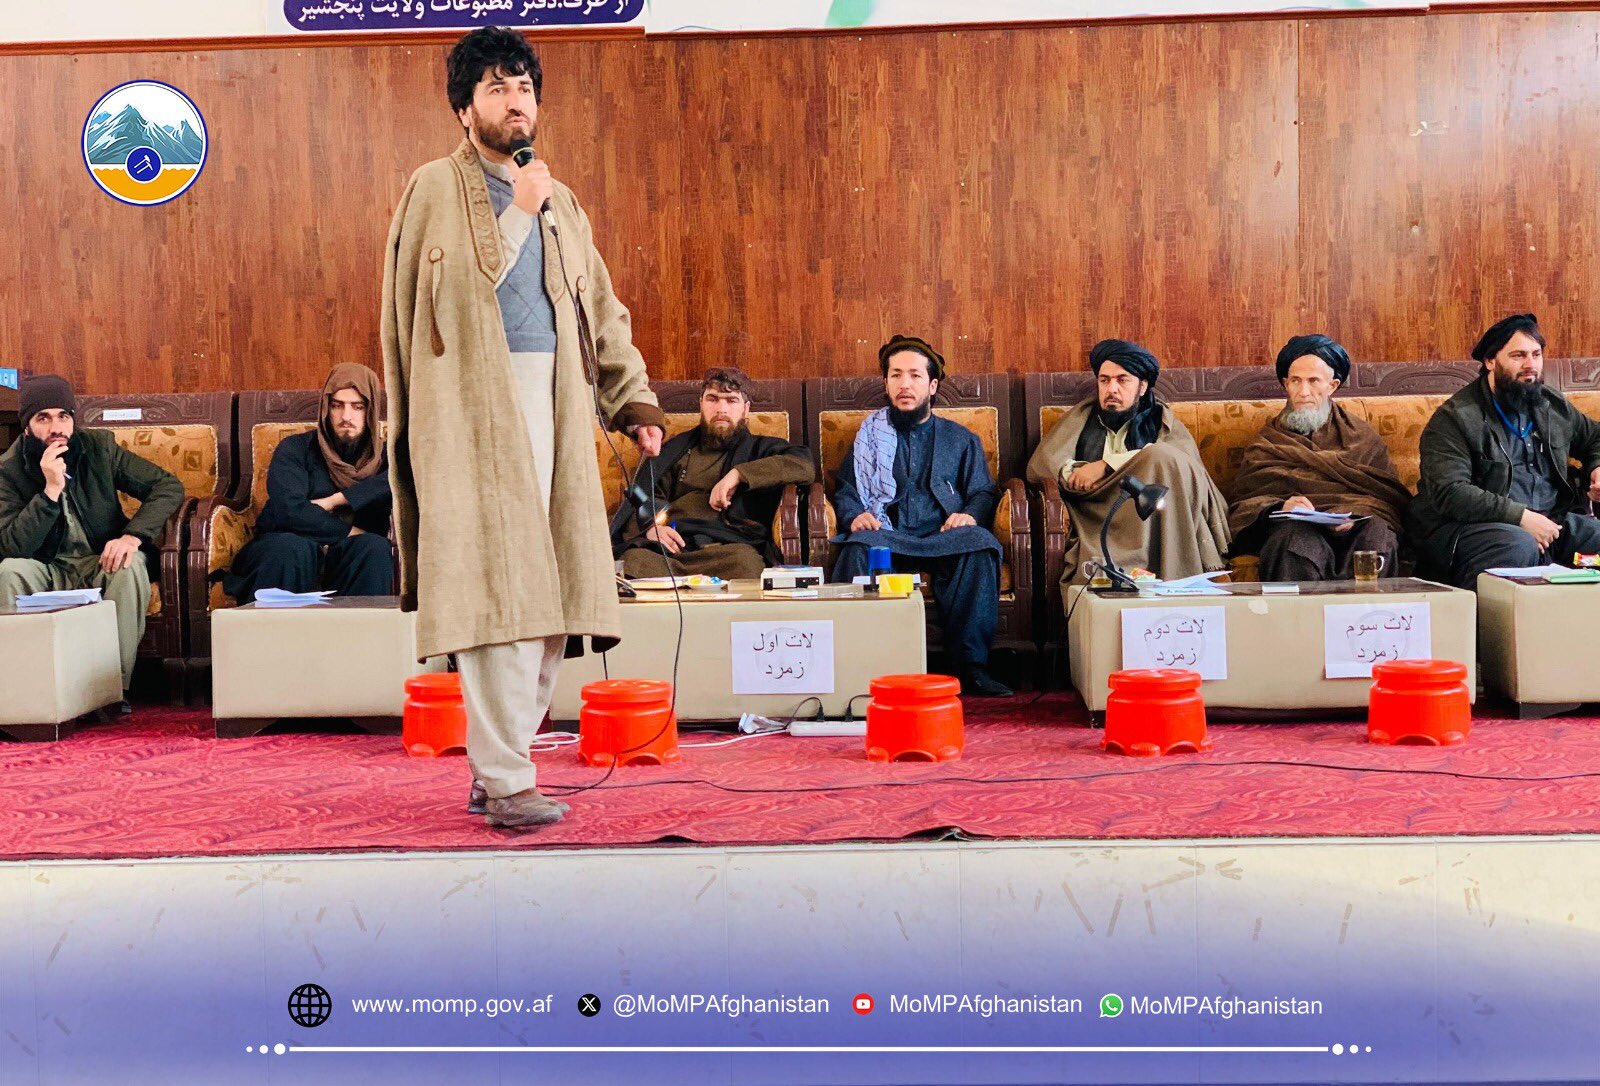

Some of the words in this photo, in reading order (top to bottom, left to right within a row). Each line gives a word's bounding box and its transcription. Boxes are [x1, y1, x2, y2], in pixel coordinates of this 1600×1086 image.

[298, 0, 365, 23] پنجشیر
[1143, 622, 1170, 641] دوم
[1176, 618, 1205, 634] لات
[1346, 623, 1378, 638] سوم
[1383, 615, 1413, 631] لات
[752, 633, 779, 653] اول
[785, 633, 814, 649] لات
[1156, 647, 1197, 667] زمرد
[1357, 645, 1399, 663] زمرد
[765, 661, 805, 680] زمرد
